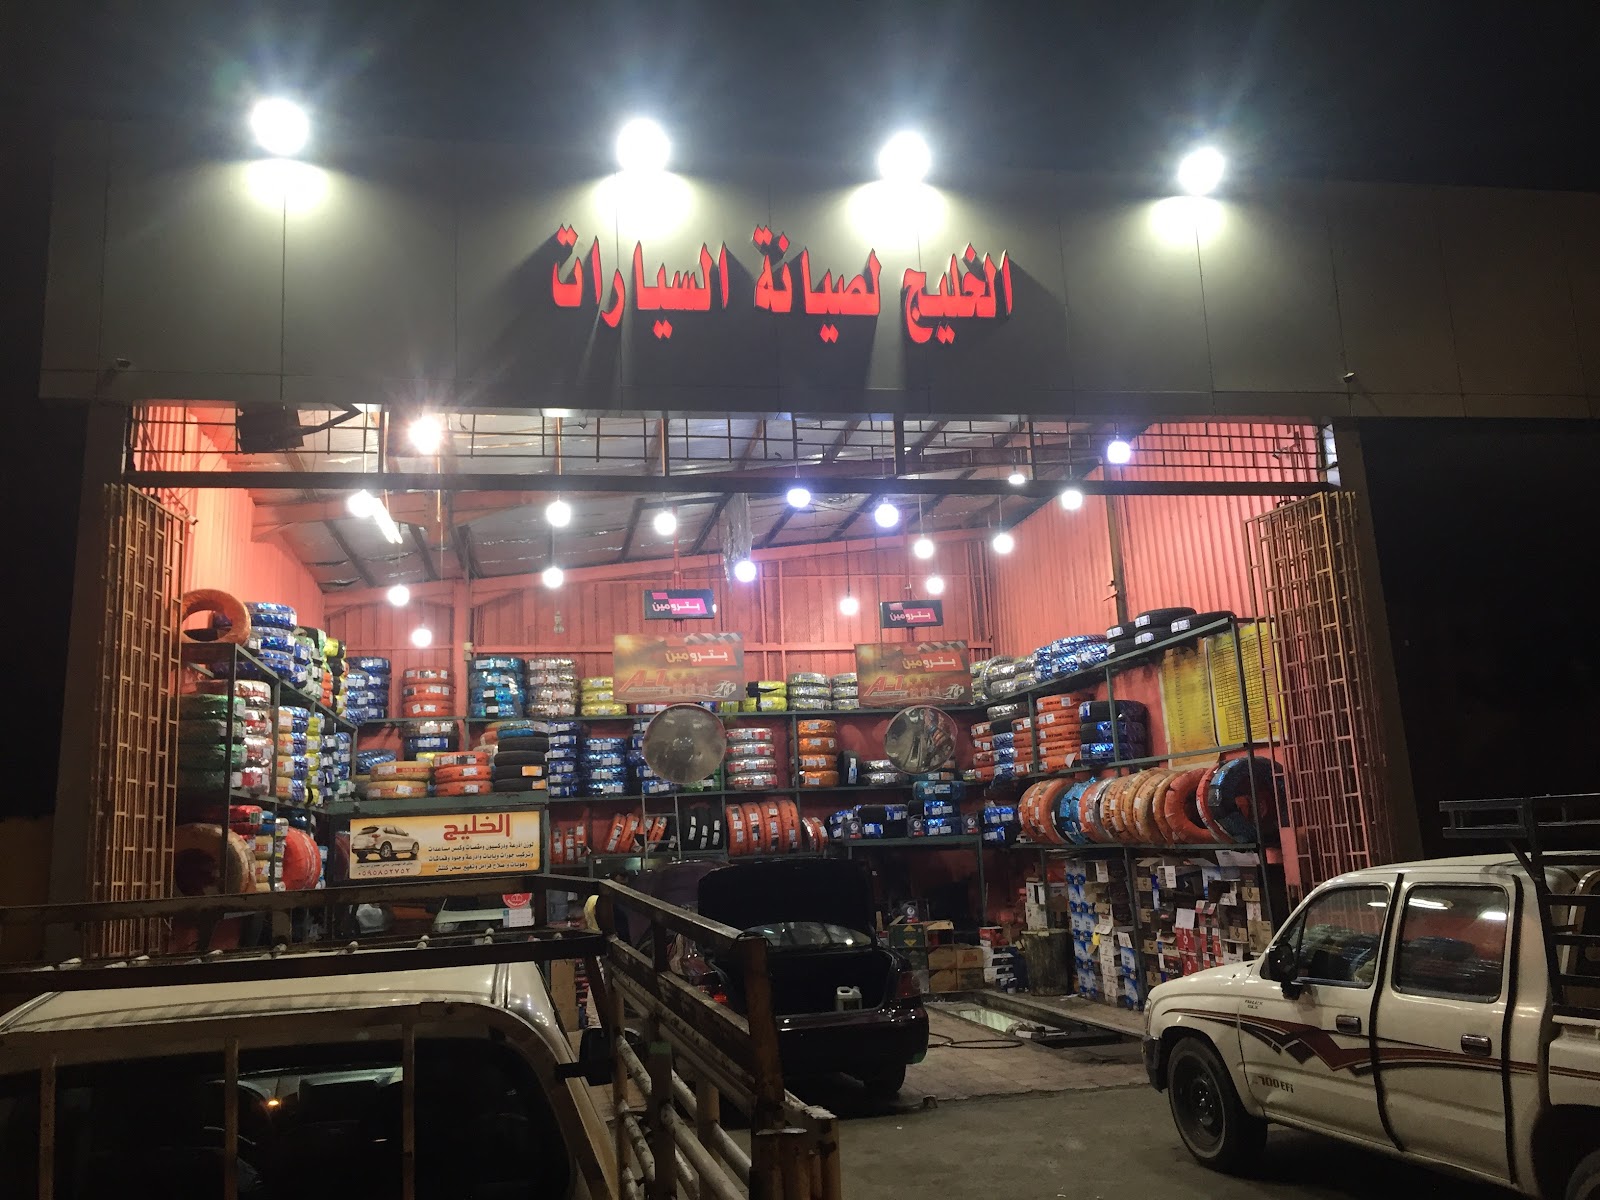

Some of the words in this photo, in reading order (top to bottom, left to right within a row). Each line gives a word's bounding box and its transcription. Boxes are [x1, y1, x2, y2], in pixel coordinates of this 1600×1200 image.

[552, 224, 728, 340] السيارات
[752, 224, 882, 344] لصيانة
[902, 242, 1013, 344] الخليج
[652, 601, 700, 612] بترومين
[889, 611, 931, 622] بترومين
[665, 649, 728, 663] بترومين
[902, 656, 956, 669] بترومين
[443, 813, 511, 841] الخليج
